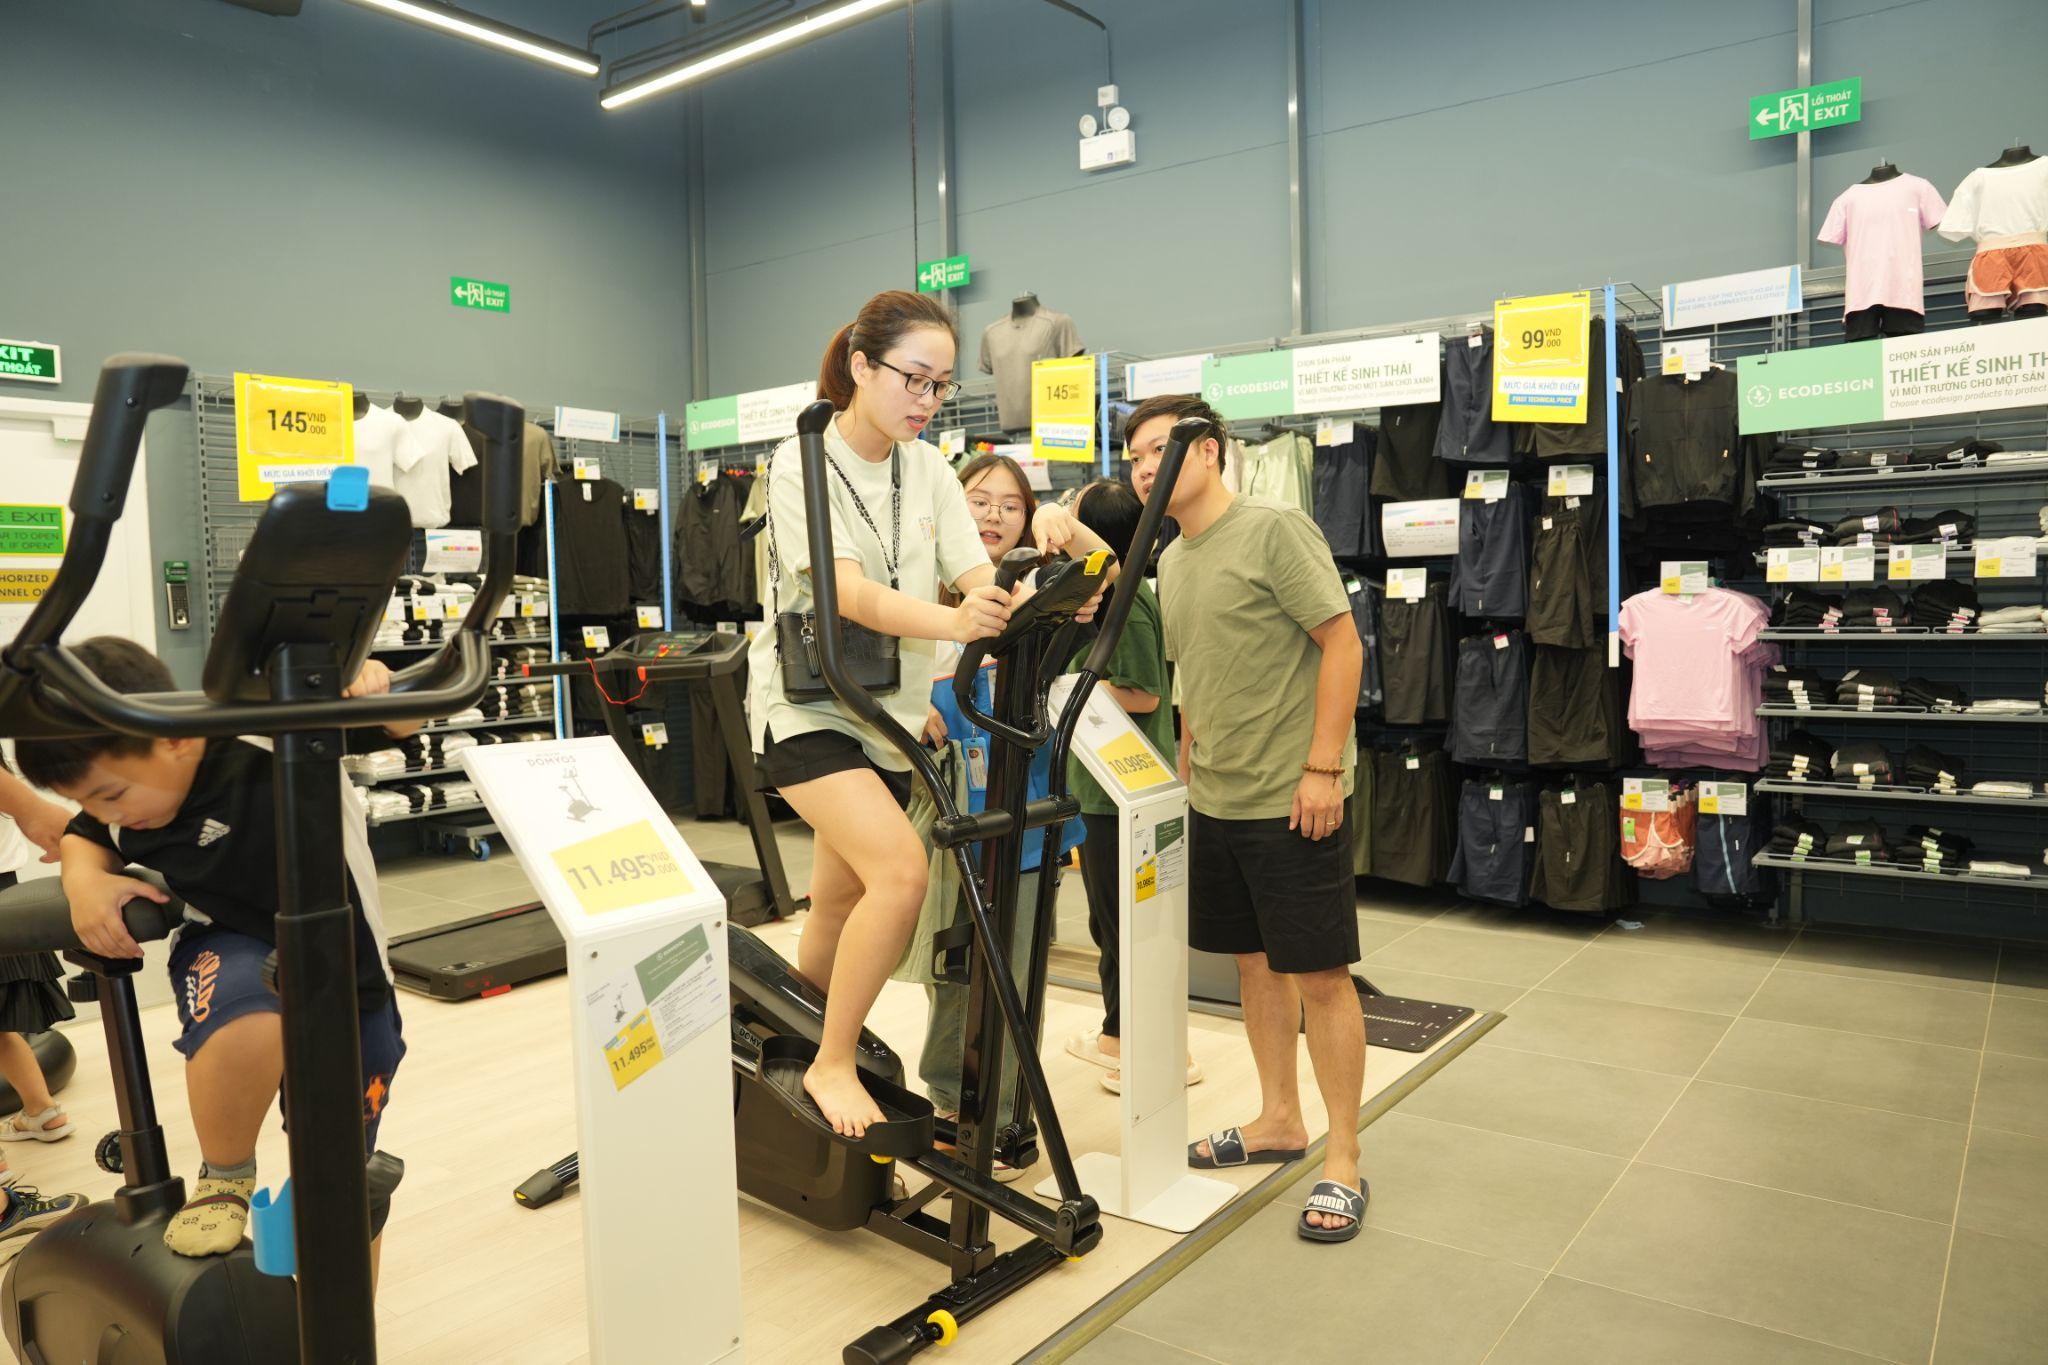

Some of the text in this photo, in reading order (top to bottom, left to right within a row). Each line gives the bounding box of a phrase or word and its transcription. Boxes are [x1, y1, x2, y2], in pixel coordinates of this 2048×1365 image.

[1812, 89, 1852, 106] LỐI THOÁT
[1815, 103, 1849, 121] EXIT
[1522, 328, 1561, 349] 99 VND
[1889, 341, 1975, 363] CHỌN SẢN PHẨM
[1298, 362, 1412, 386] THIẾT KẾ SINH THÁI
[1890, 360, 1941, 384] THIẾT
[1947, 355, 1972, 378] KẾ
[1976, 354, 2022, 375] SINH
[1046, 384, 1068, 401] 145
[1226, 378, 1288, 396] ECODESIGN
[1778, 378, 1874, 400] ECODESIGN
[1890, 370, 2045, 398] VÌ MÔI TRƯỜNG CHO MỘT SÂN
[1890, 384, 2048, 409] Choose ecodesign products to protect
[267, 409, 326, 433] 145 VND
[11, 511, 58, 523] EXIT
[1108, 754, 1149, 775] 10.995
[567, 854, 656, 890] 11.495
[613, 1041, 647, 1071] 11.495
[1306, 1194, 1346, 1212] PUMA
